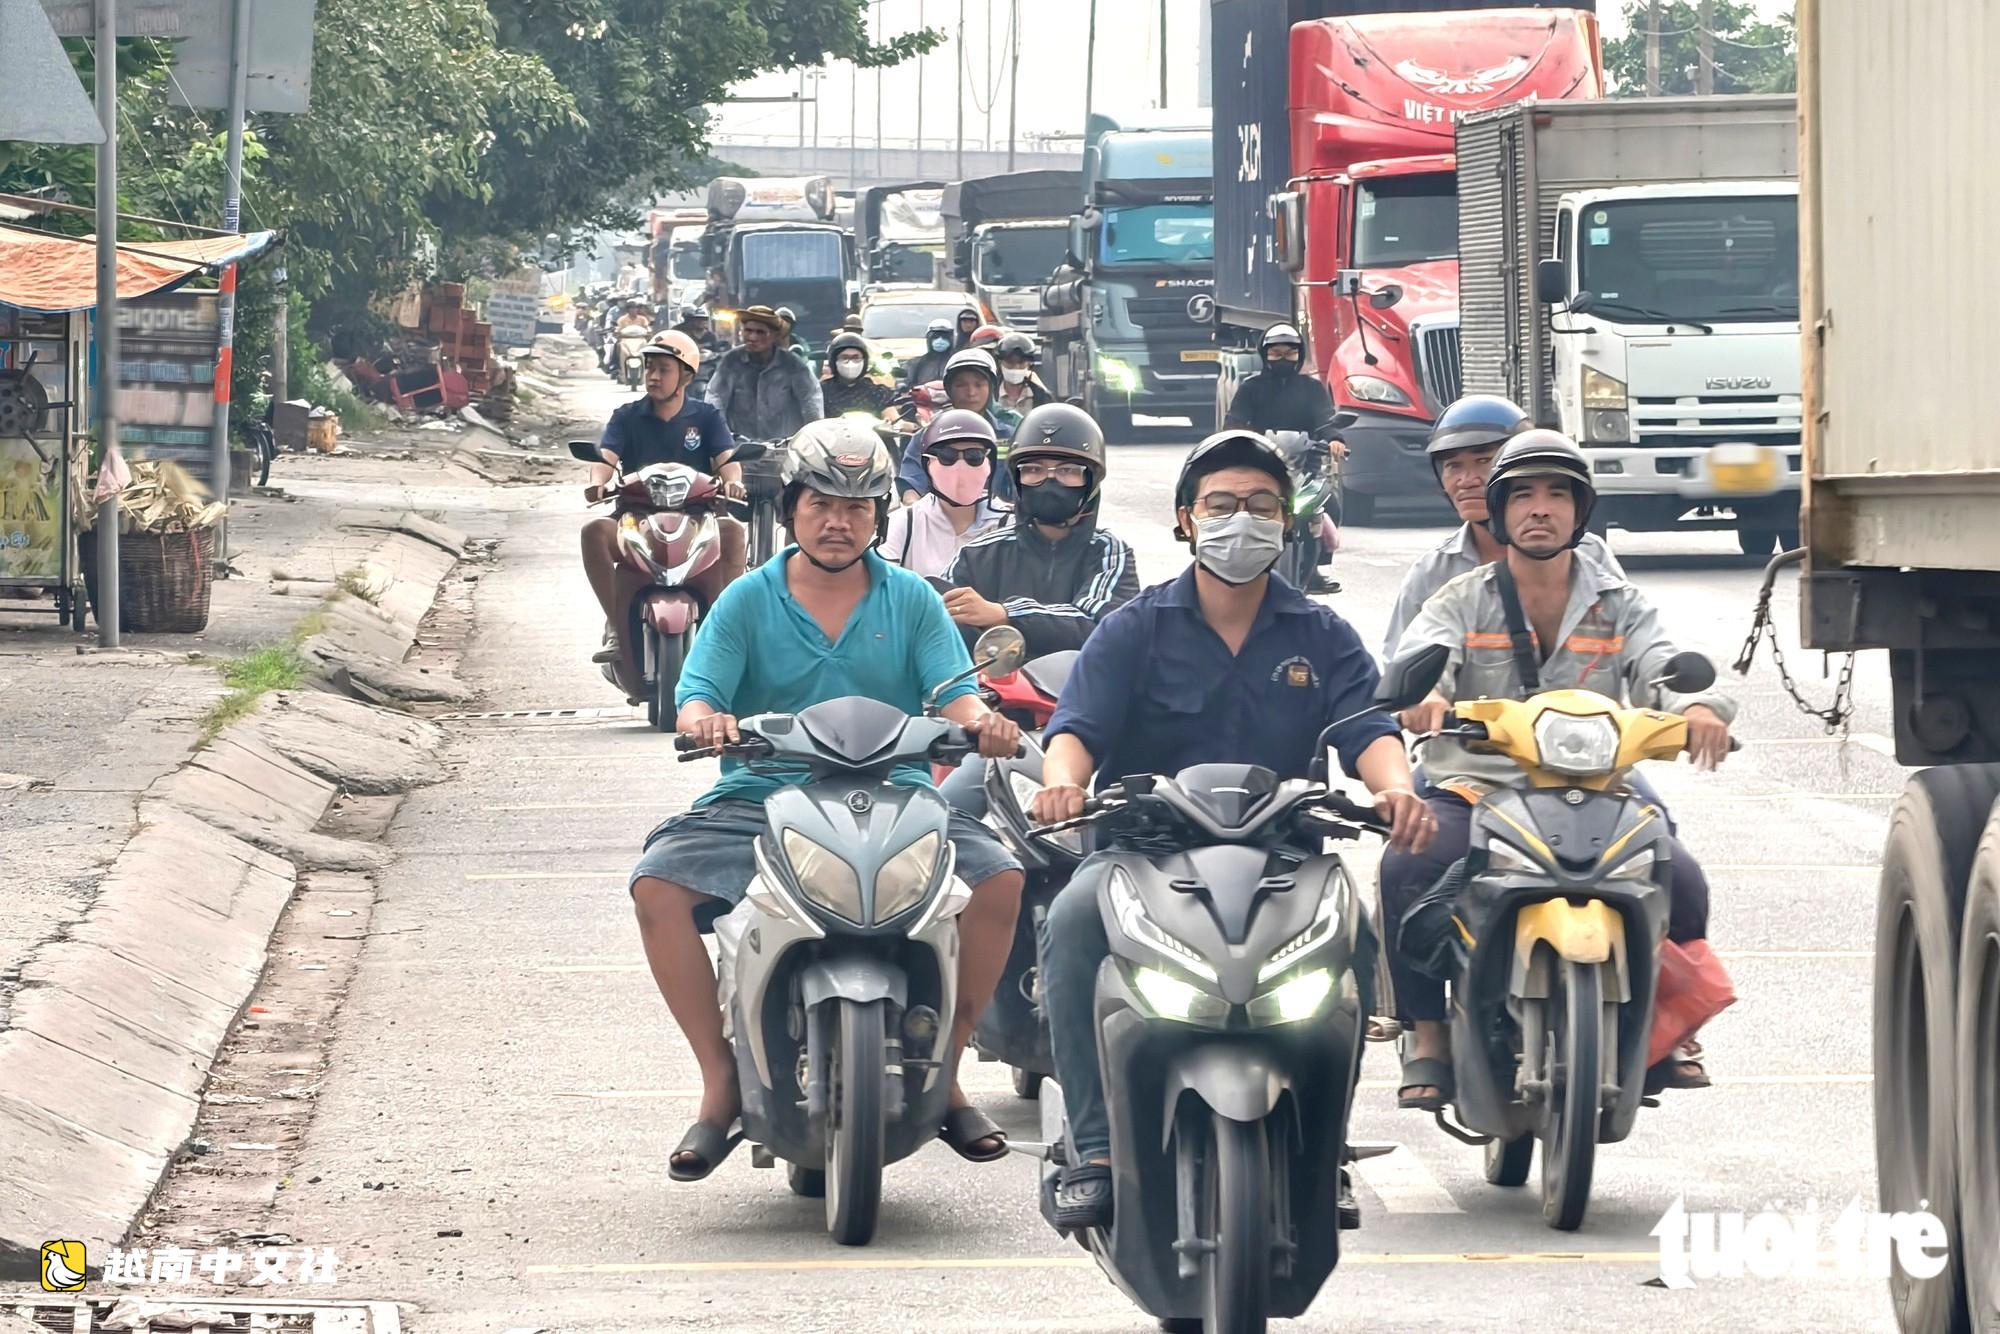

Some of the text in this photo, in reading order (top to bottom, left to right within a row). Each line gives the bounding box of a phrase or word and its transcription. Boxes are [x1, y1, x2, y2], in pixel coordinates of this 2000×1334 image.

[1404, 99, 1445, 124] VIỆT
[1167, 279, 1215, 288] SHACM
[1705, 376, 1771, 390] ISUZU
